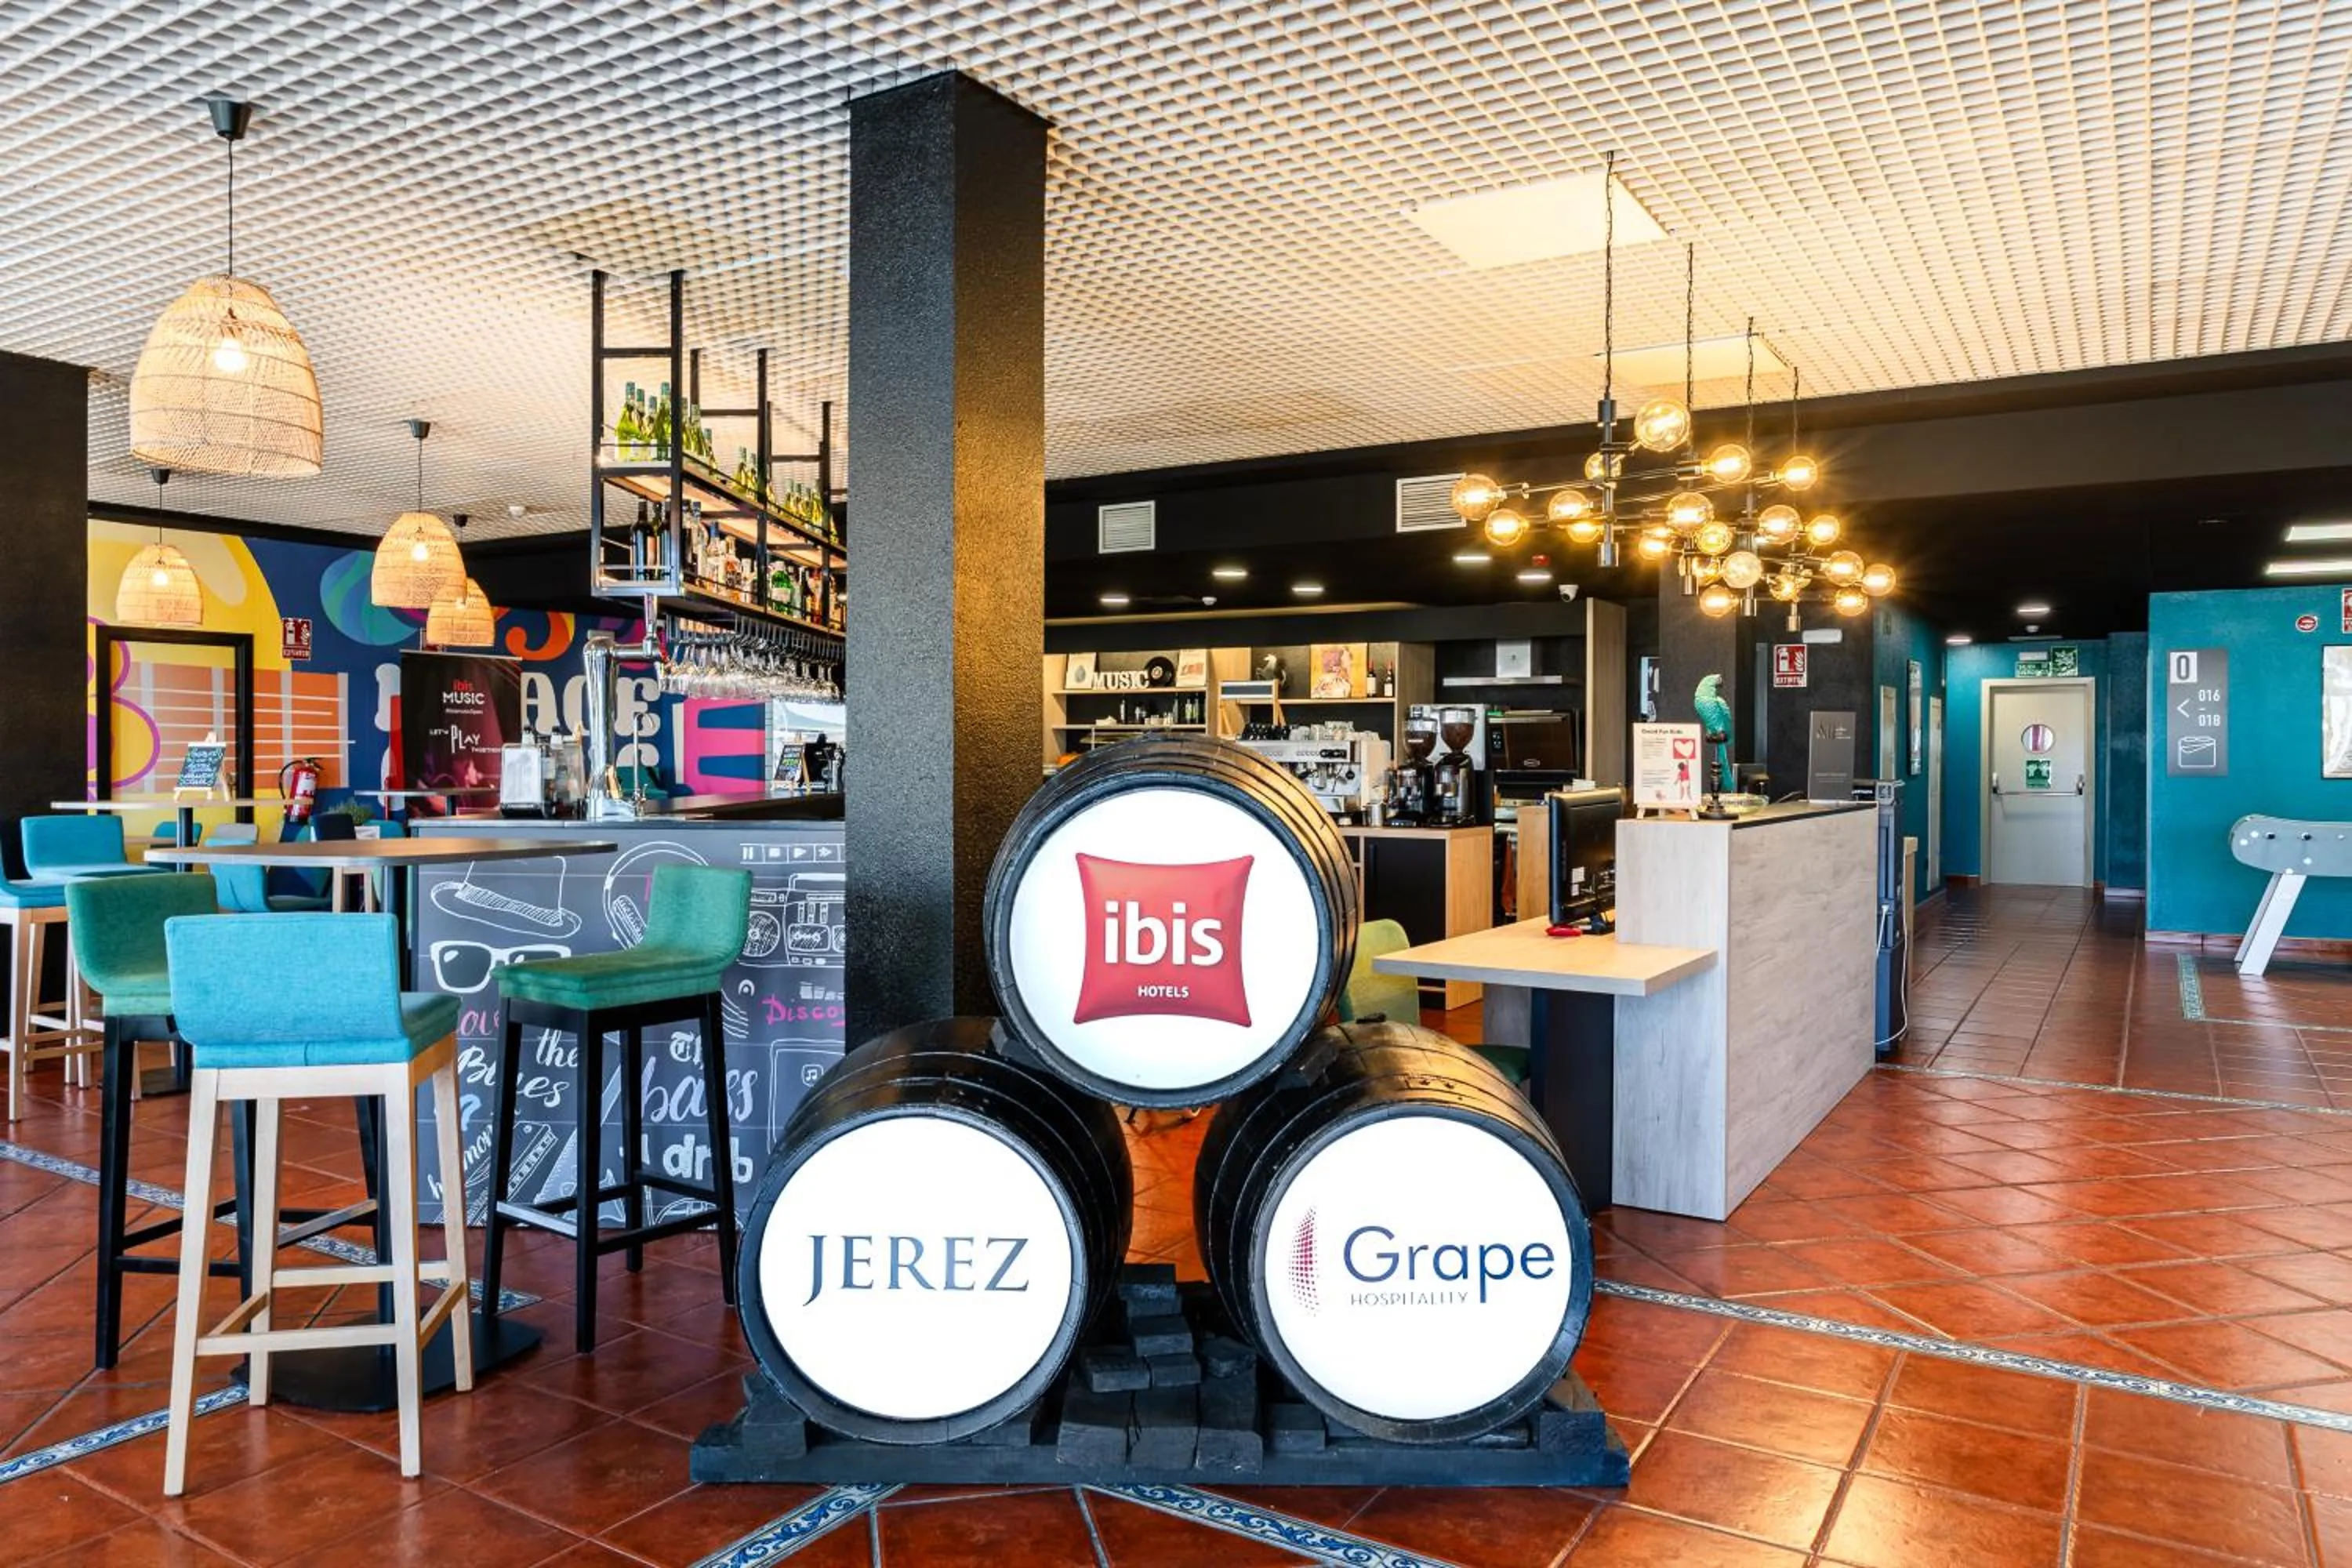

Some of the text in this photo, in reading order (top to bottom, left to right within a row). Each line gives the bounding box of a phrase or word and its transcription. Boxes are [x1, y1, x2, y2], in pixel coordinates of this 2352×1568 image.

[2176, 655, 2190, 681] 0
[1092, 670, 1150, 690] MUSIC
[442, 691, 485, 705] MUSIC
[2198, 689, 2221, 702] 016
[2198, 714, 2221, 727] 018
[451, 724, 481, 754] PLAY
[1105, 900, 1224, 967] ibis
[1138, 985, 1189, 998] HOTELS
[802, 1235, 1029, 1307] JEREZ
[1343, 1225, 1555, 1303] Grape
[1350, 1291, 1469, 1305] HOSPITALITY
